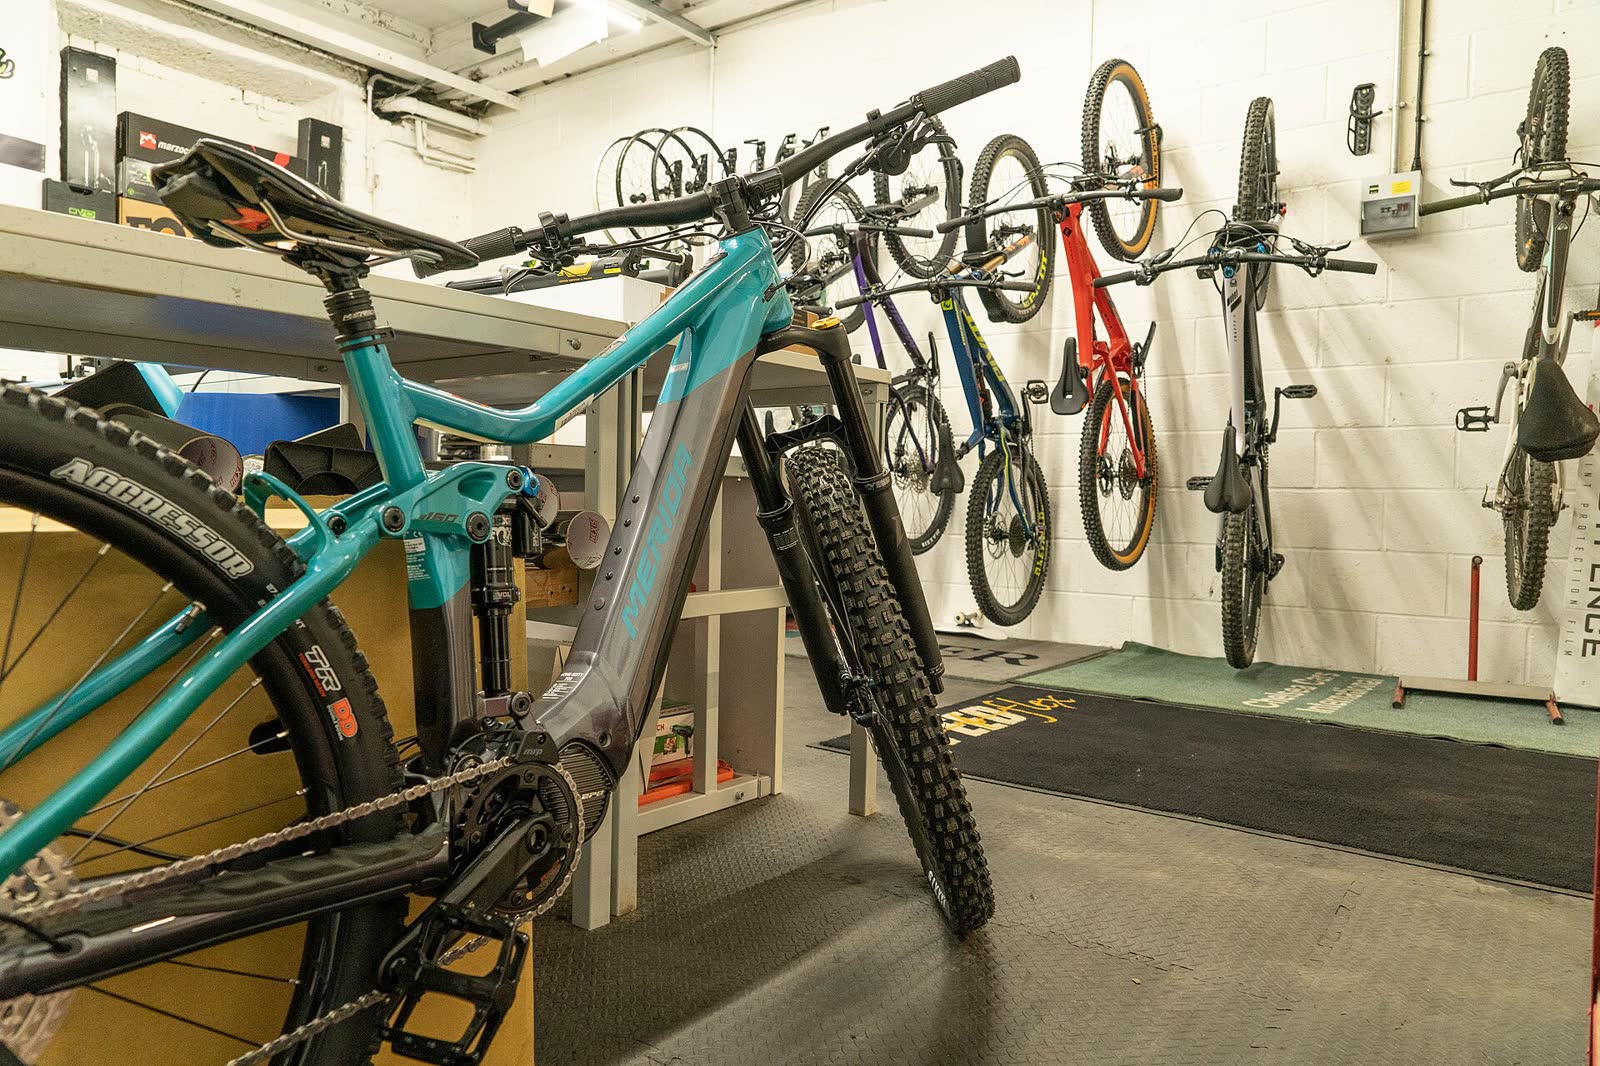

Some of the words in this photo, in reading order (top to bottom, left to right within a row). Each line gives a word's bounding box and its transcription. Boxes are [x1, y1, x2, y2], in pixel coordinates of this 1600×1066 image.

[158, 141, 191, 155] marzoc
[1583, 451, 1595, 488] AINT
[50, 457, 255, 580] AGGRESSOR
[621, 441, 694, 640] MERIDA
[1569, 502, 1589, 605] PROTECTION
[1564, 620, 1576, 657] FILM
[523, 748, 544, 757] mrp
